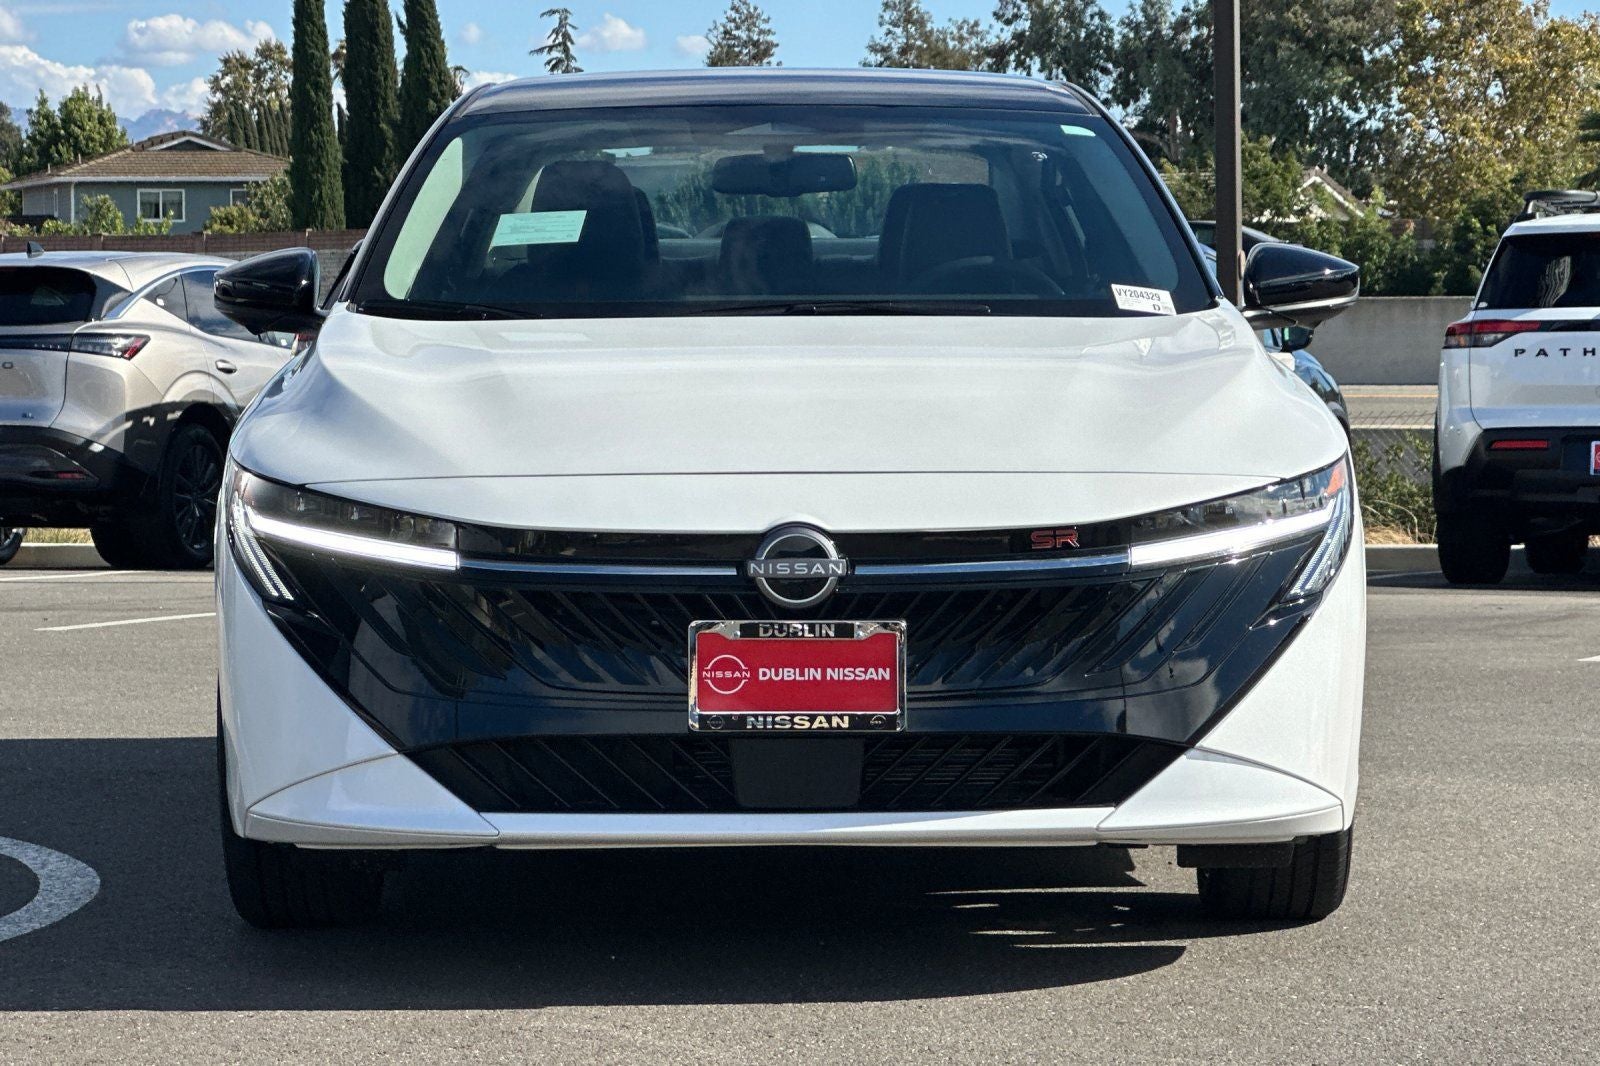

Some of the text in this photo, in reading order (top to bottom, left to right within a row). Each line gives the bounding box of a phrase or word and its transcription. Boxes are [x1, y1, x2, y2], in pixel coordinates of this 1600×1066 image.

[1115, 287, 1161, 302] VY204329
[1514, 348, 1596, 357] PATH
[1030, 529, 1080, 549] SR
[750, 562, 844, 575] NISSAN
[758, 623, 835, 638] DUBLIN
[702, 670, 751, 679] NISSAN
[758, 667, 891, 681] DUBLIN NISSAN
[746, 715, 850, 729] NISSAN
